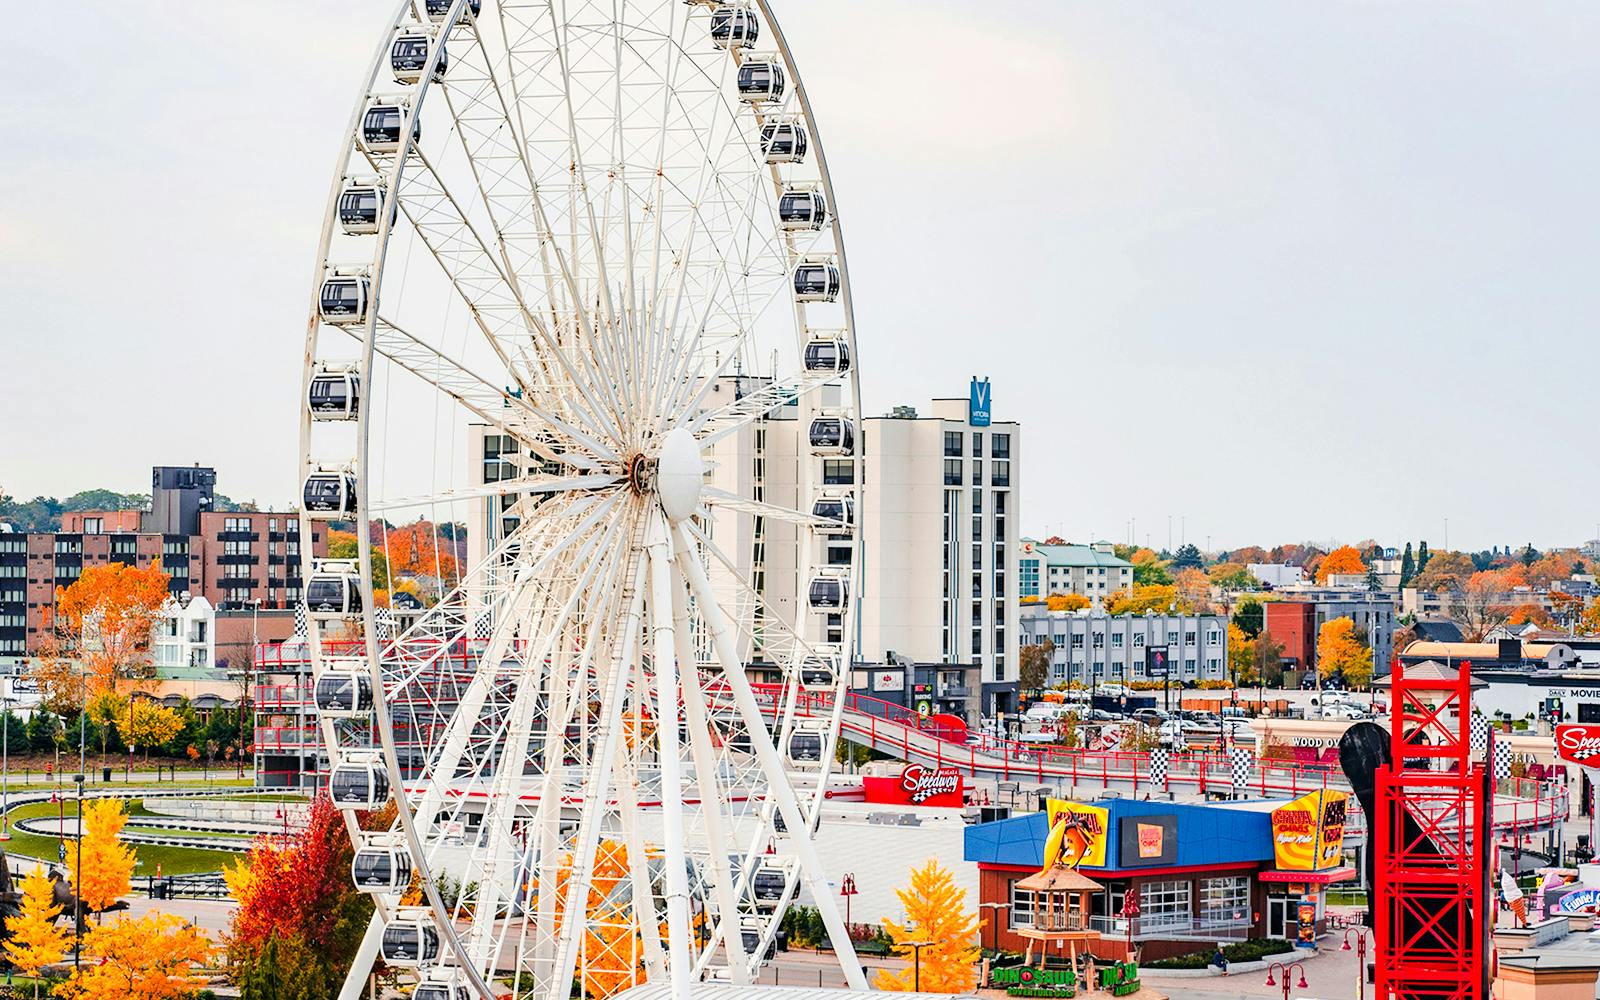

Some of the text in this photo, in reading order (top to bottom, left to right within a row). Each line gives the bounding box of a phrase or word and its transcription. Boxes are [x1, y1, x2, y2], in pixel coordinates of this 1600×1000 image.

[1292, 736, 1341, 748] WOOD OV
[903, 765, 959, 792] Speedway
[1564, 892, 1594, 912] Funnel
[993, 966, 1076, 985] DINOSAUR
